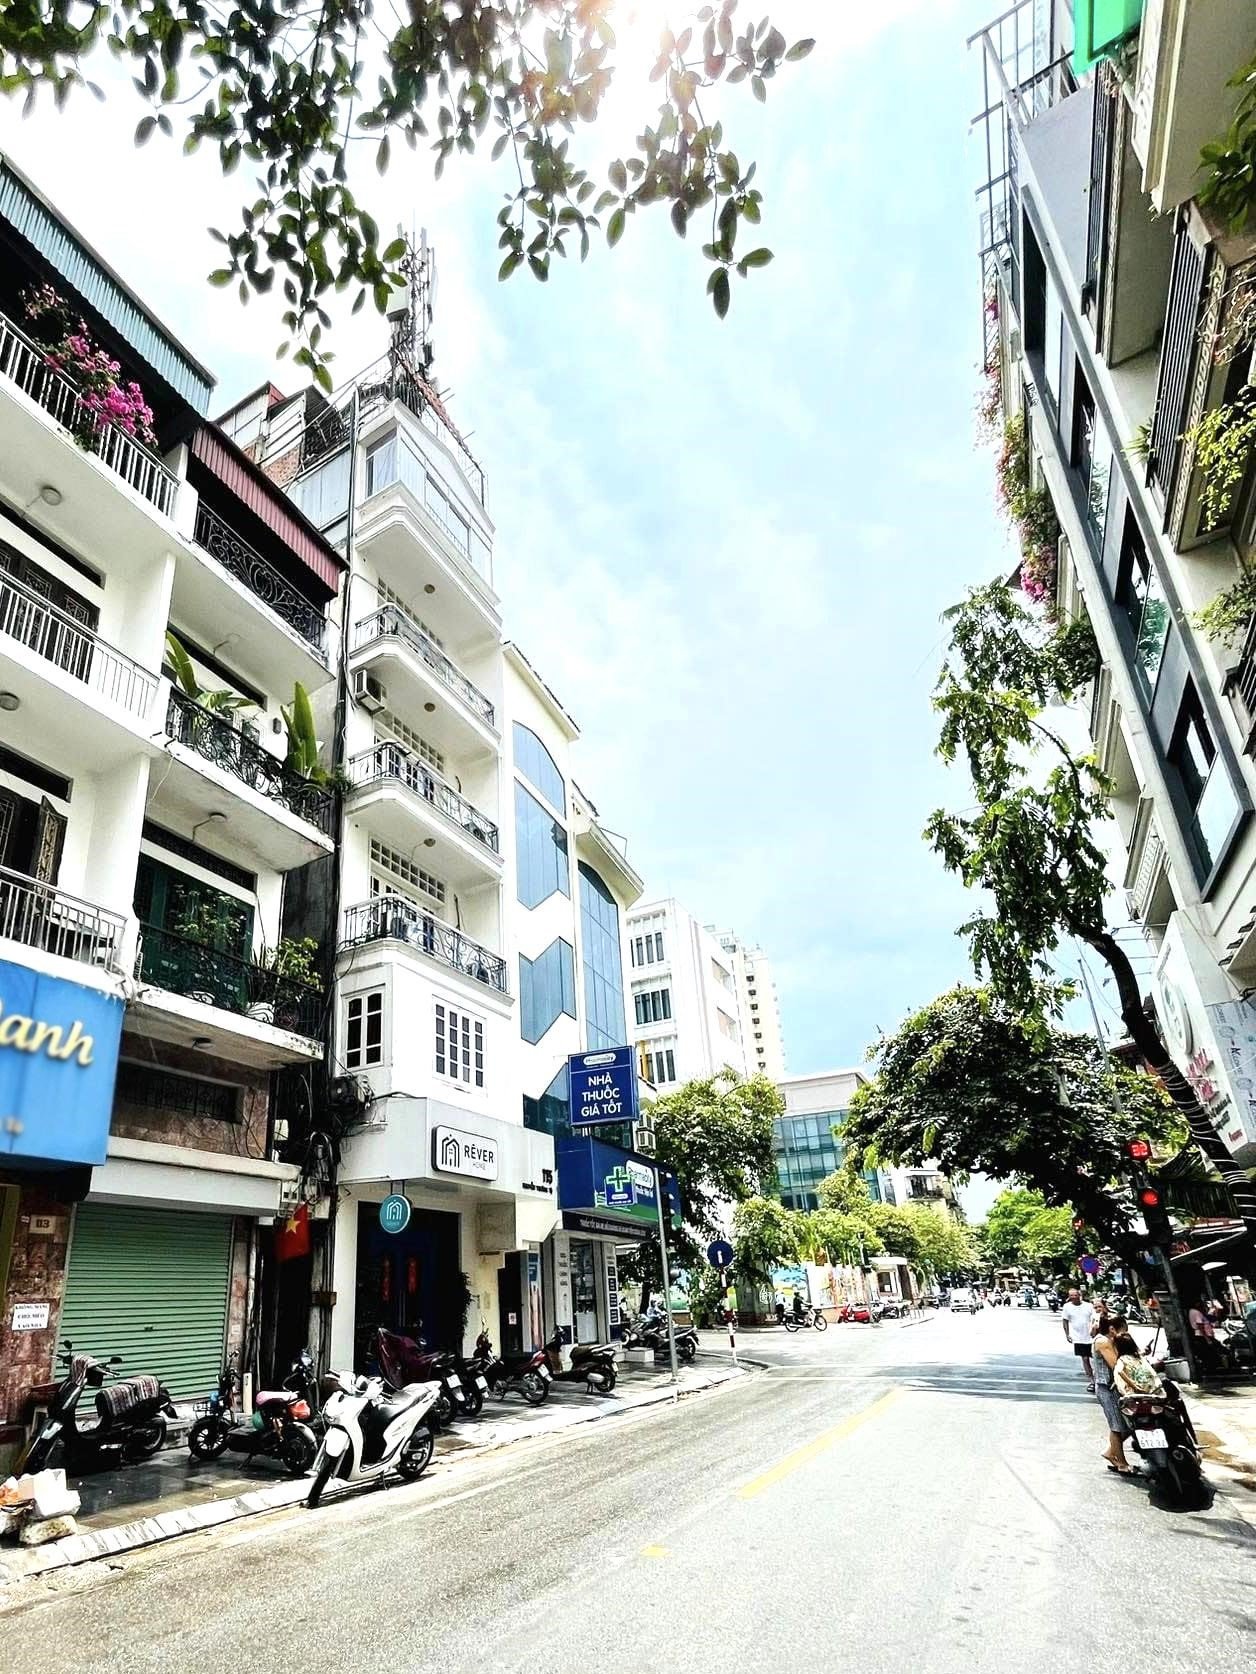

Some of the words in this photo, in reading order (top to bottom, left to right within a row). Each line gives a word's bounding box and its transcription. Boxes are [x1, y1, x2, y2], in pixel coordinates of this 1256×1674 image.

[0, 1000, 94, 1066] anh
[588, 1071, 613, 1087] NHÀ
[582, 1084, 620, 1102] THUỐC
[581, 1102, 600, 1117] GIÁ
[602, 1099, 623, 1114] TỐT
[464, 1143, 494, 1163] RÊVER
